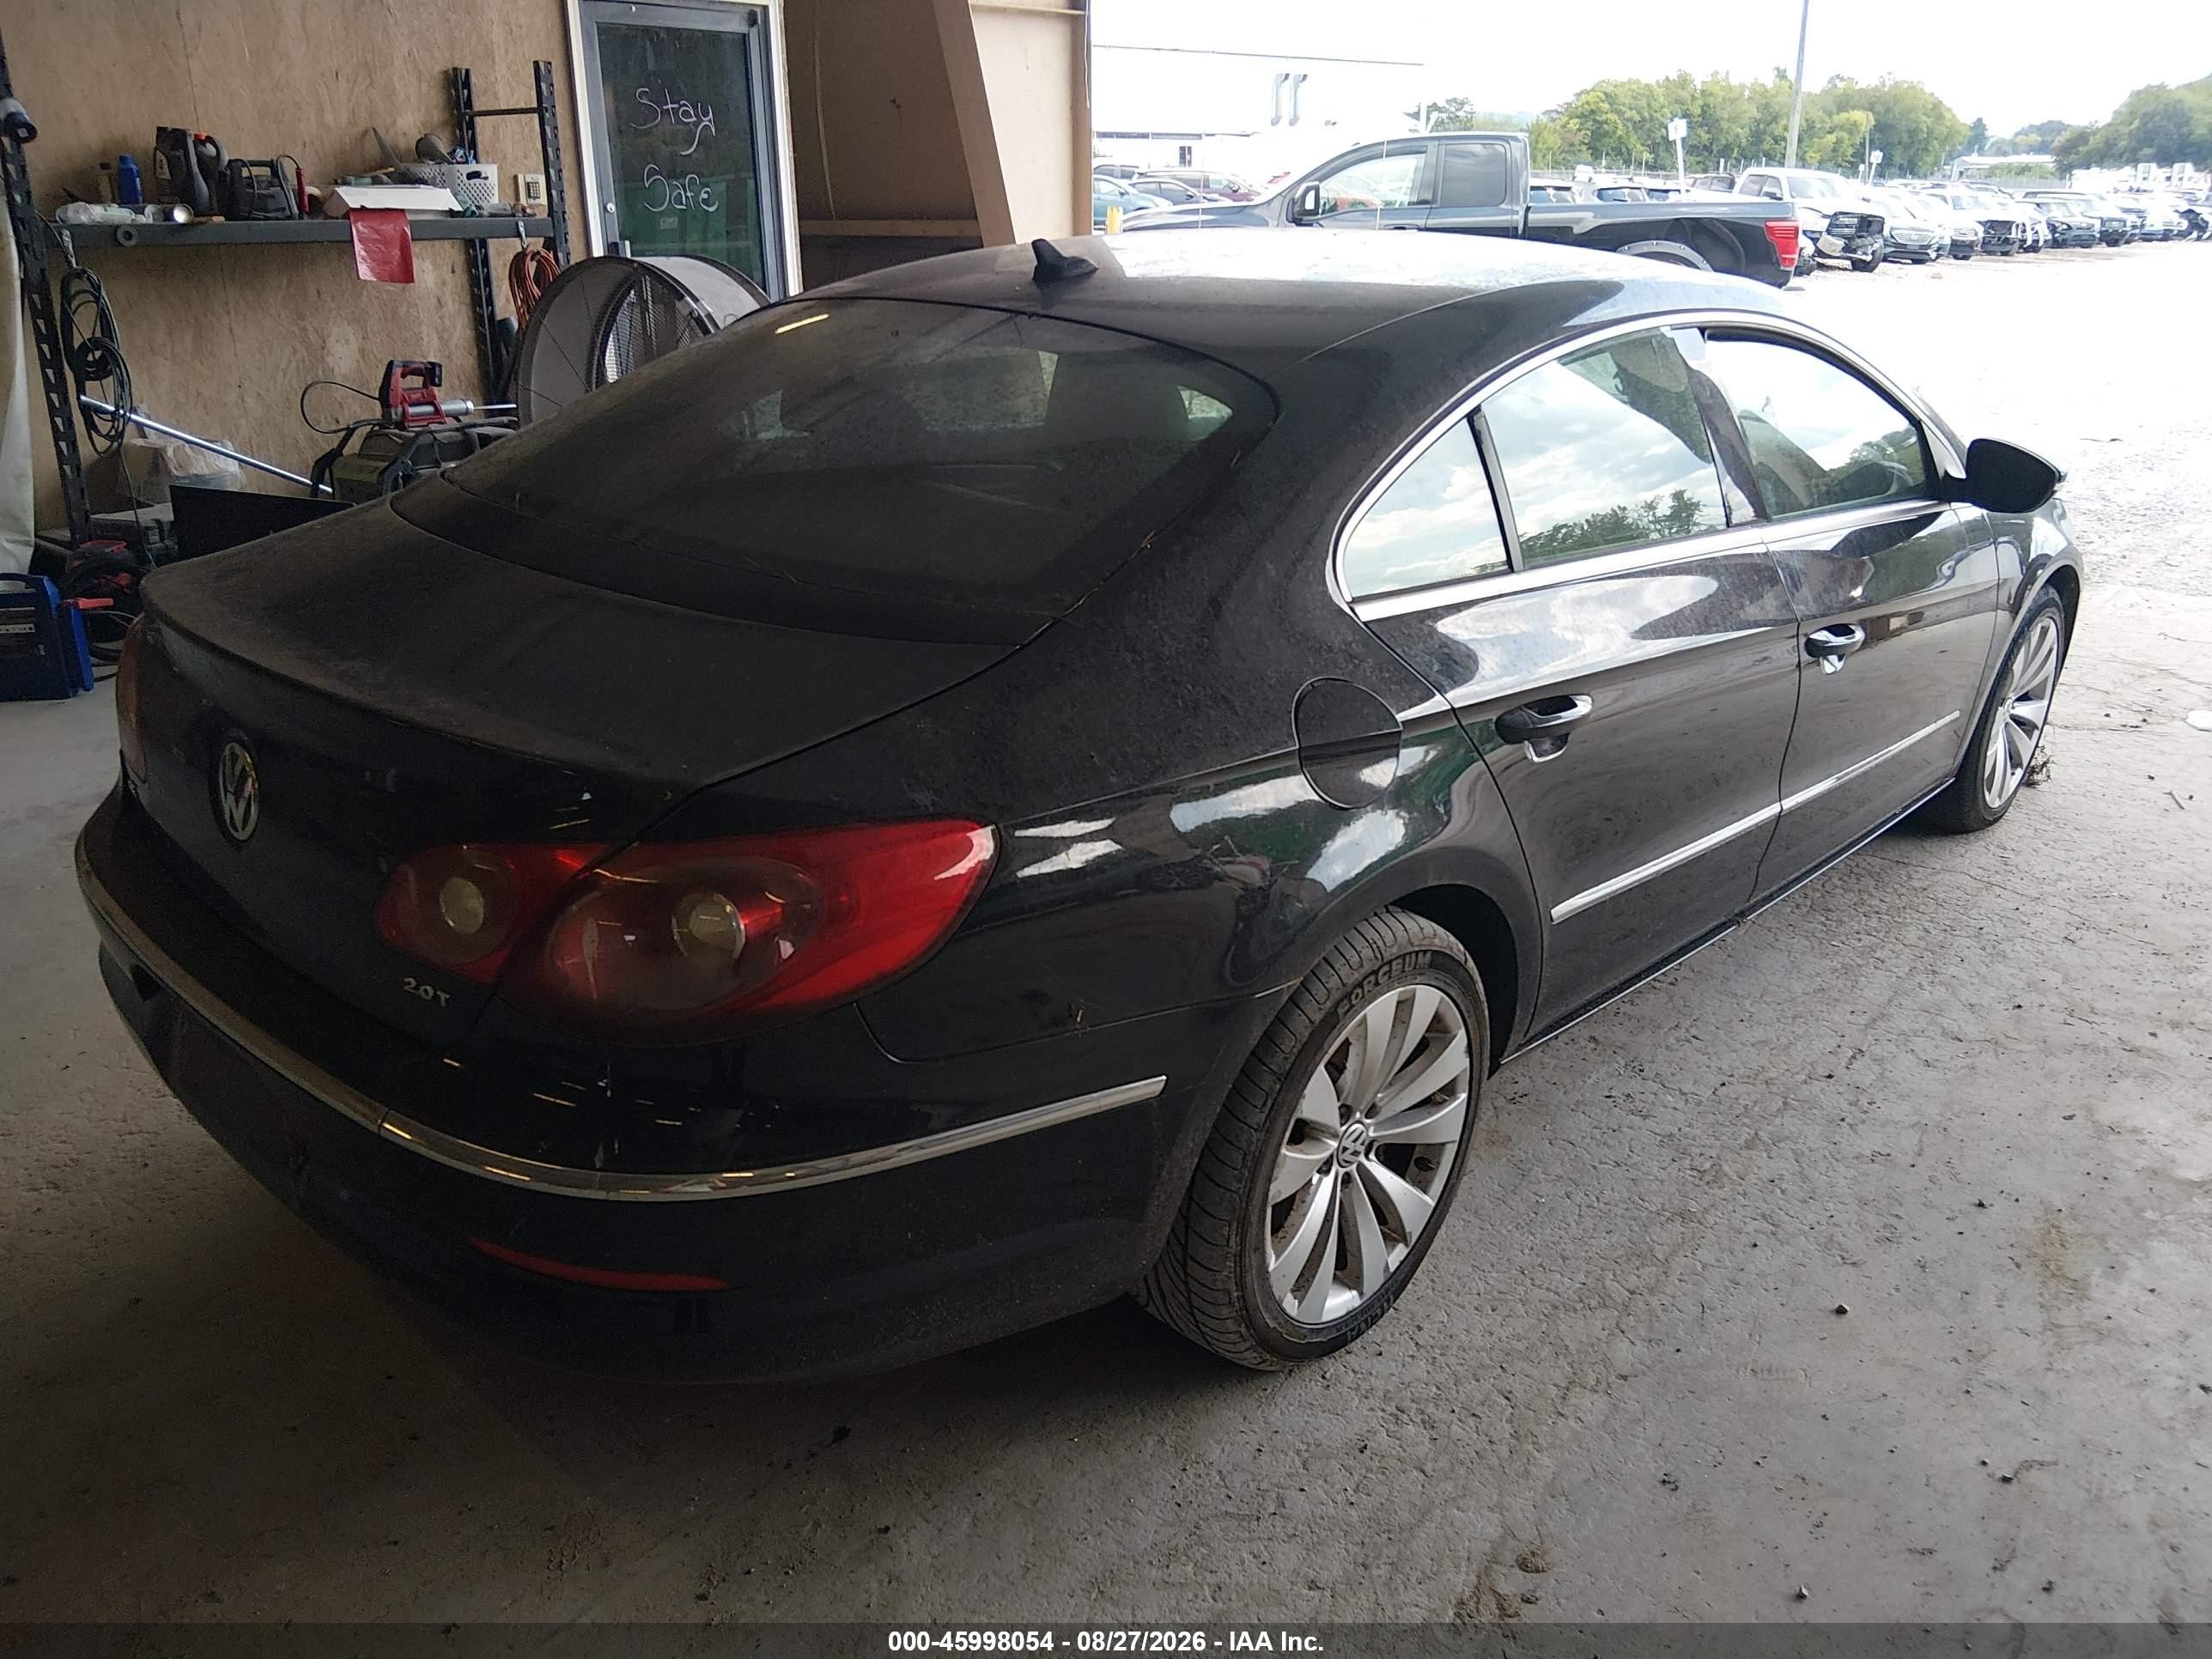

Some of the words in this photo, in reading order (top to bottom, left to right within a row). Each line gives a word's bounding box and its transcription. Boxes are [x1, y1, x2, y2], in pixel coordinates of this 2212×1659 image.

[631, 88, 715, 155] Stay
[644, 164, 719, 212] Safe
[403, 975, 453, 1008] 2.0T
